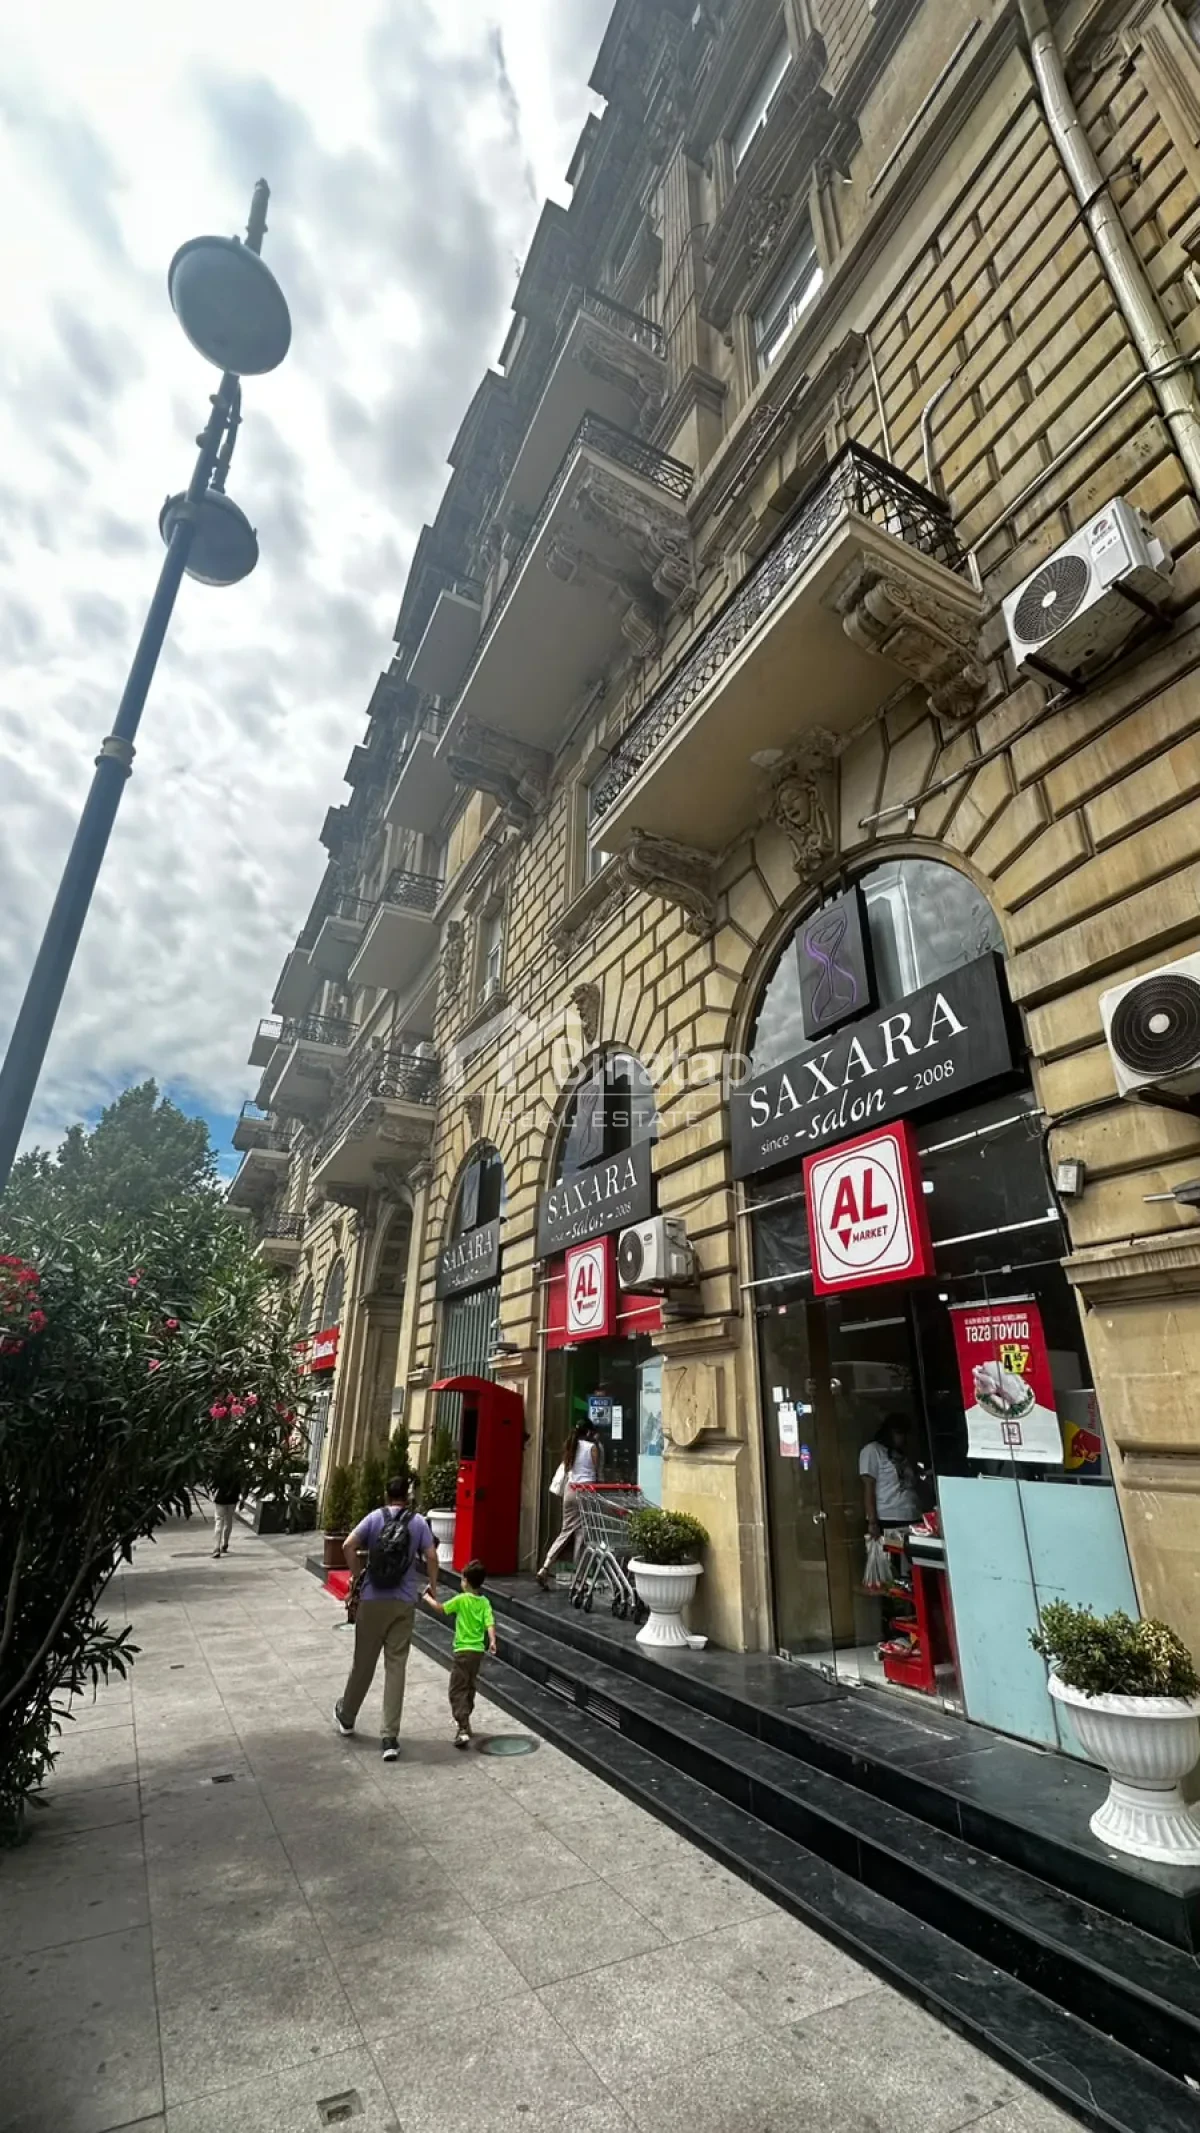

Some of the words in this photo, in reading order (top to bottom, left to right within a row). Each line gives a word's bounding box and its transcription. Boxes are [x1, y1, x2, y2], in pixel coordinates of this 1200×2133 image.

[749, 992, 969, 1129] SAXARA
[760, 1133, 790, 1155] since
[913, 1059, 956, 1091] 2008
[547, 1156, 638, 1225] SAXARA
[830, 1167, 889, 1230] AL
[852, 1224, 889, 1243] MARKET
[574, 1262, 598, 1301] AL
[1003, 1353, 1013, 1372] 4
